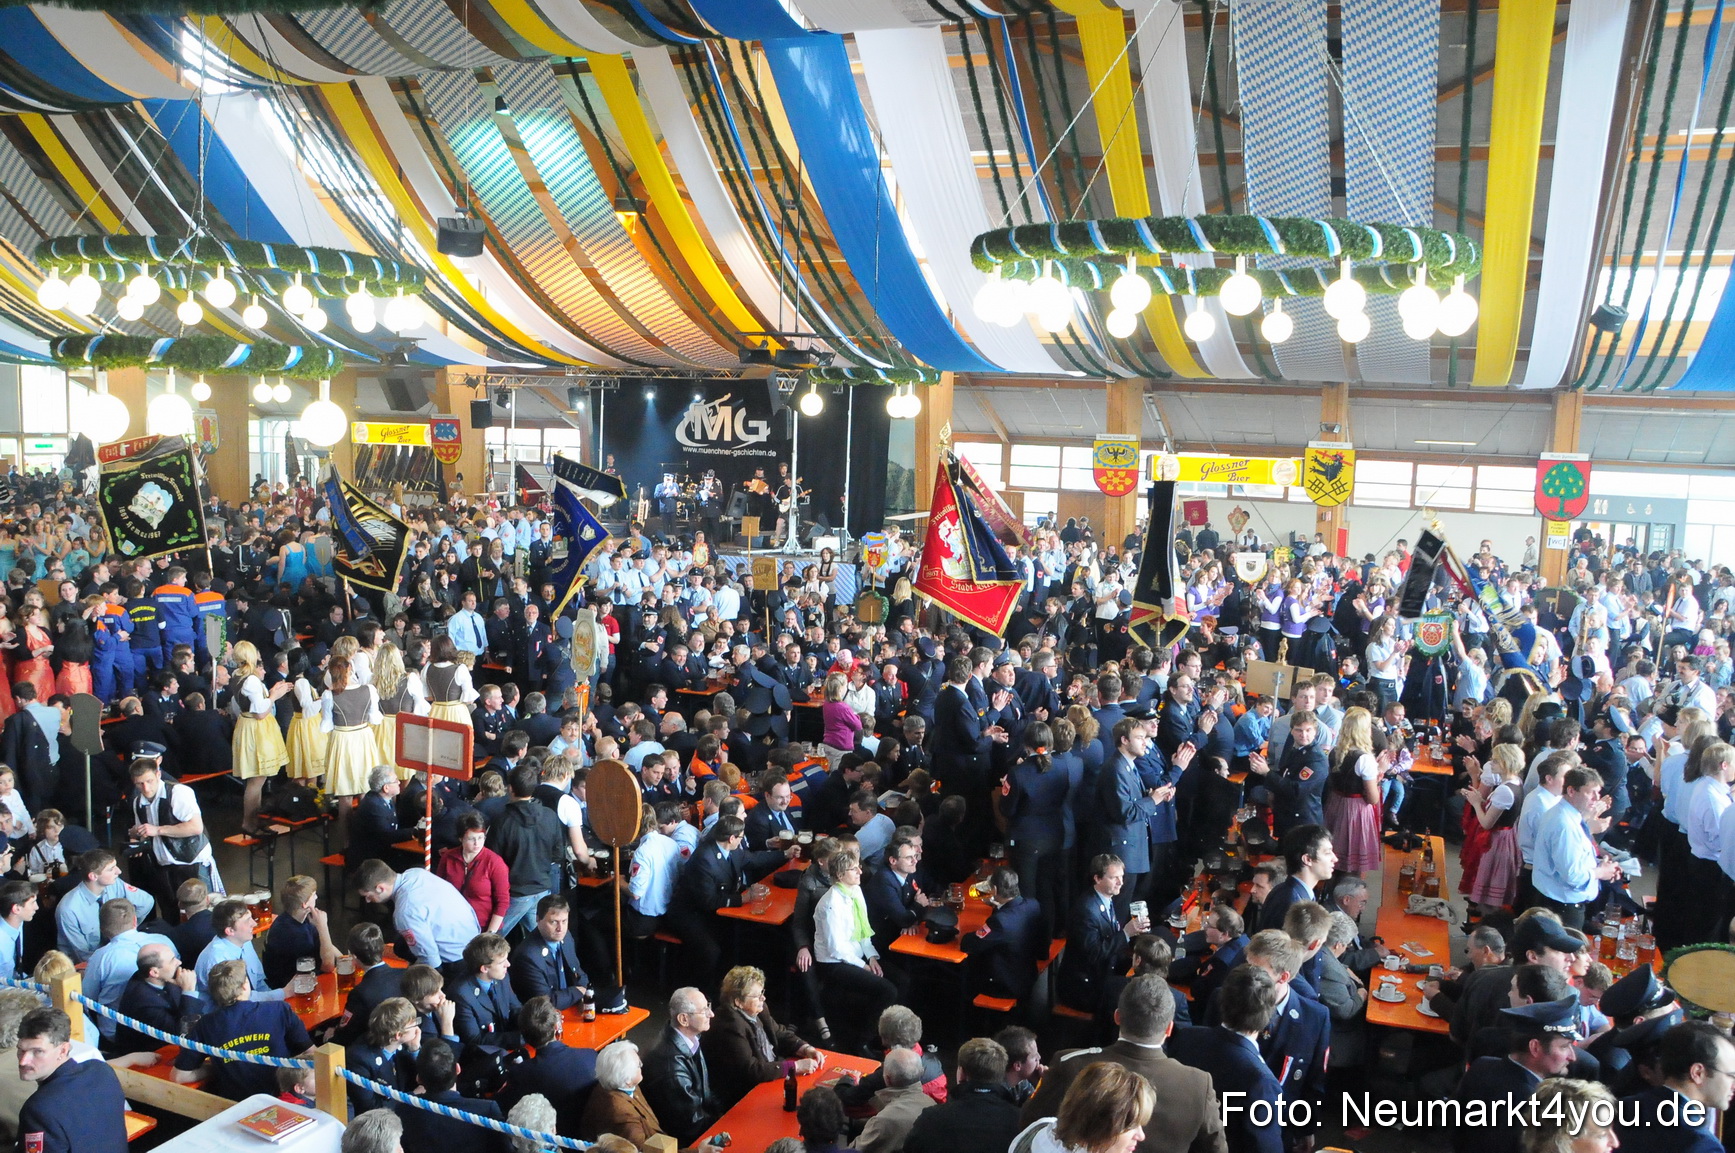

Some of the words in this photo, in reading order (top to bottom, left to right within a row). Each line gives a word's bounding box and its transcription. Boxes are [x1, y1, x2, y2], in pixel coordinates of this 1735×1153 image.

[682, 446, 777, 457] www.muenchner-gschichten.de
[1200, 459, 1250, 481] Glossner
[1228, 472, 1250, 482] Bier
